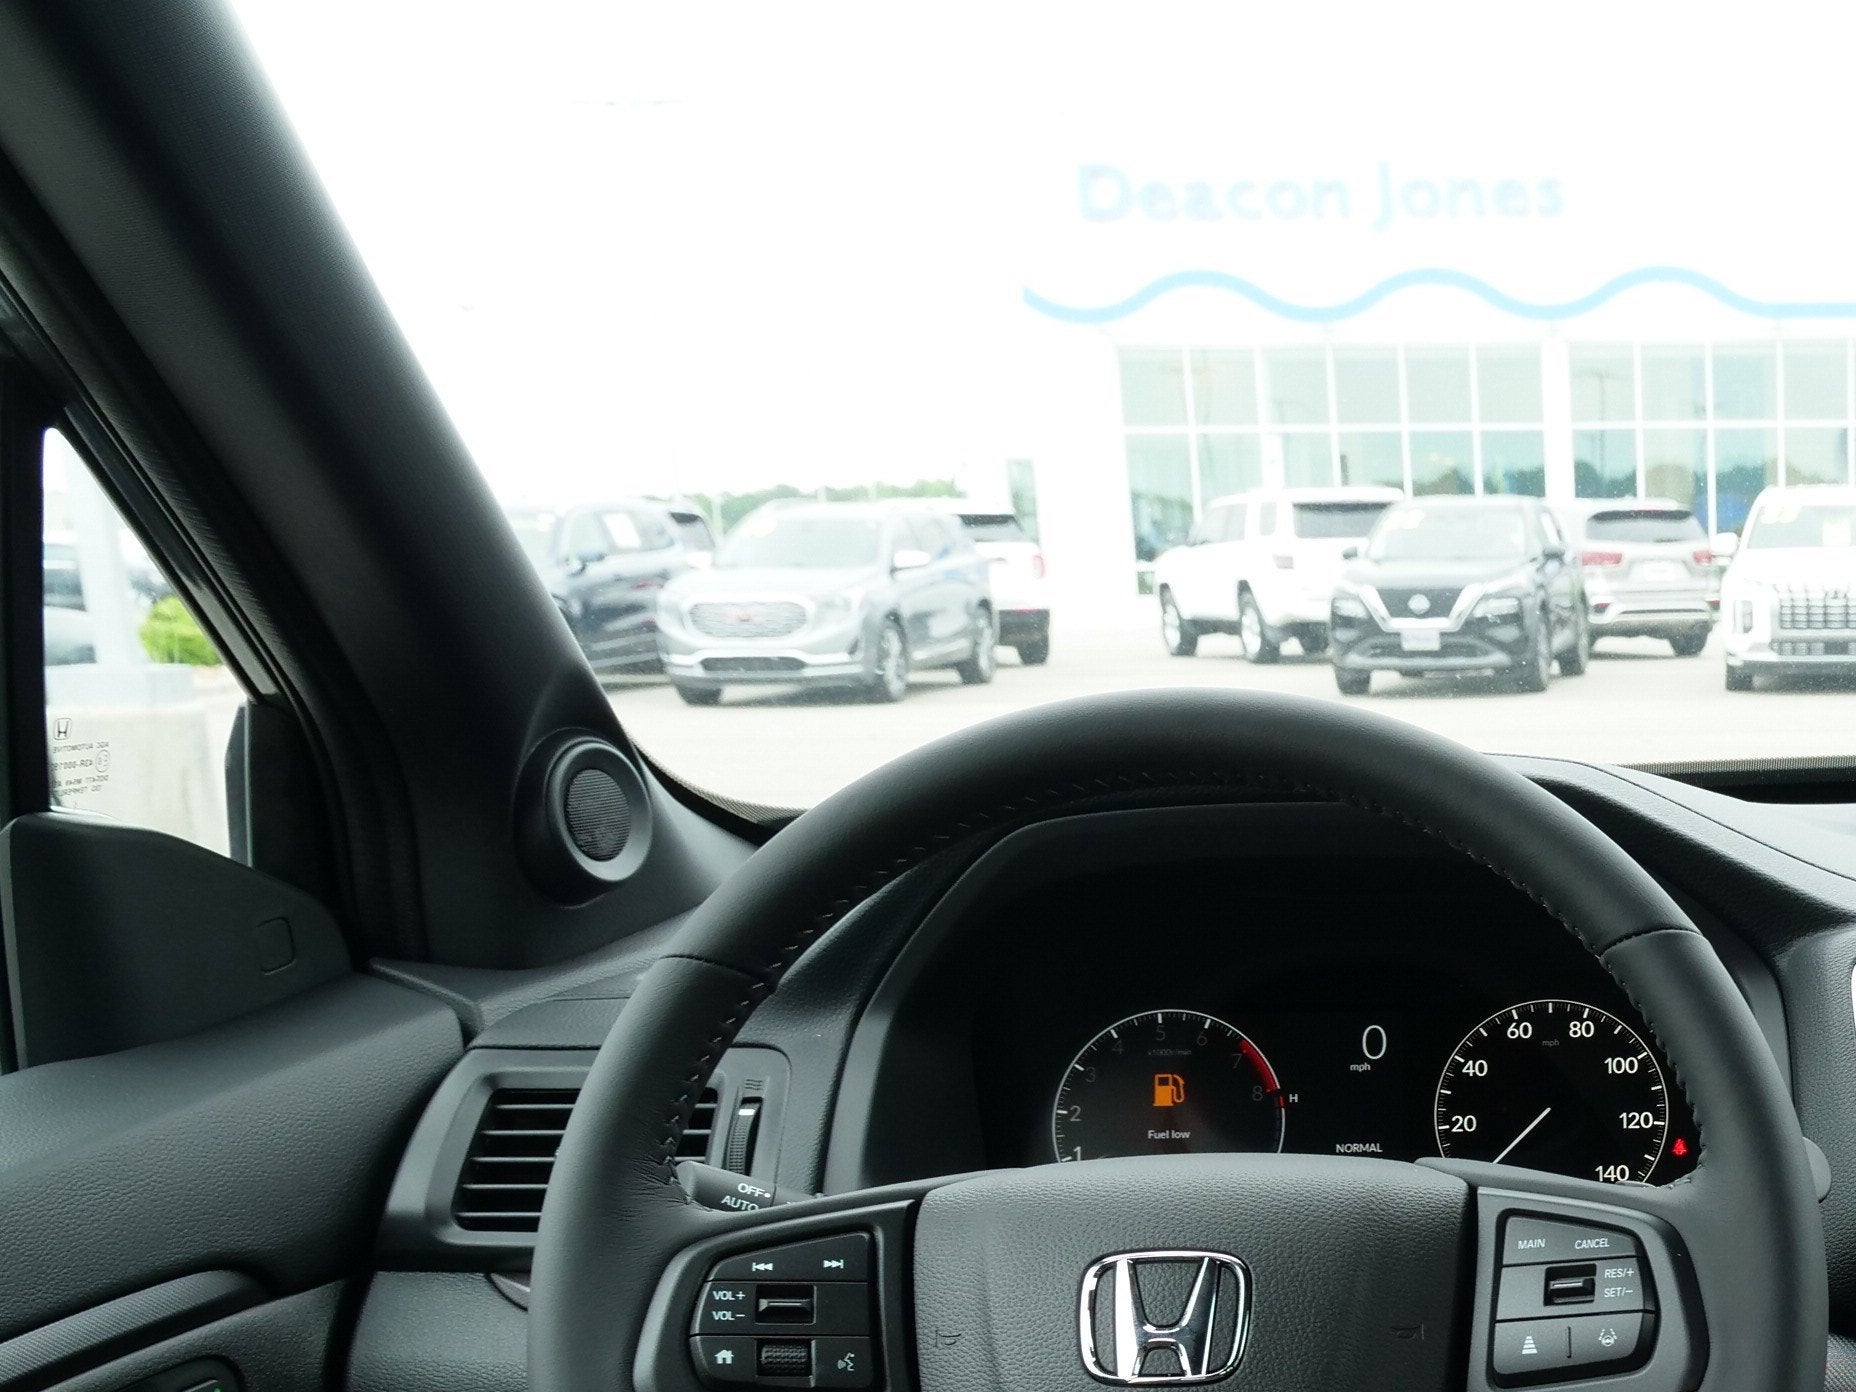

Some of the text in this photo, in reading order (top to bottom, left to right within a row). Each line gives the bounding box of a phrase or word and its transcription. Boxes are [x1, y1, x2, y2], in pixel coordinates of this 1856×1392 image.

[1074, 160, 1567, 235] Deacon Jones
[1155, 1027, 1166, 1041] 5
[1506, 1021, 1533, 1039] 60
[1568, 1020, 1595, 1039] 80
[1196, 1031, 1208, 1046] 6
[1361, 1025, 1387, 1060] 0
[1541, 1038, 1560, 1048] mph
[1111, 1041, 1125, 1055] 4
[1231, 1053, 1242, 1070] 7
[1349, 1062, 1371, 1074] mph
[1462, 1060, 1488, 1078] 40
[1604, 1057, 1639, 1075] 100
[1085, 1066, 1096, 1083] 3
[1252, 1085, 1264, 1101] 8
[1289, 1093, 1299, 1103] H
[1069, 1105, 1082, 1122] 2
[1618, 1111, 1654, 1130] 120
[1450, 1115, 1477, 1132] 20
[1147, 1130, 1191, 1140] Fuel low
[1073, 1146, 1082, 1161] 1
[1335, 1143, 1383, 1154] NORMAL
[1594, 1164, 1630, 1183] 140
[737, 1183, 765, 1198] OFF
[721, 1195, 760, 1211] AUTO
[1517, 1238, 1546, 1250] MAIN
[1574, 1238, 1610, 1250] CANCEL
